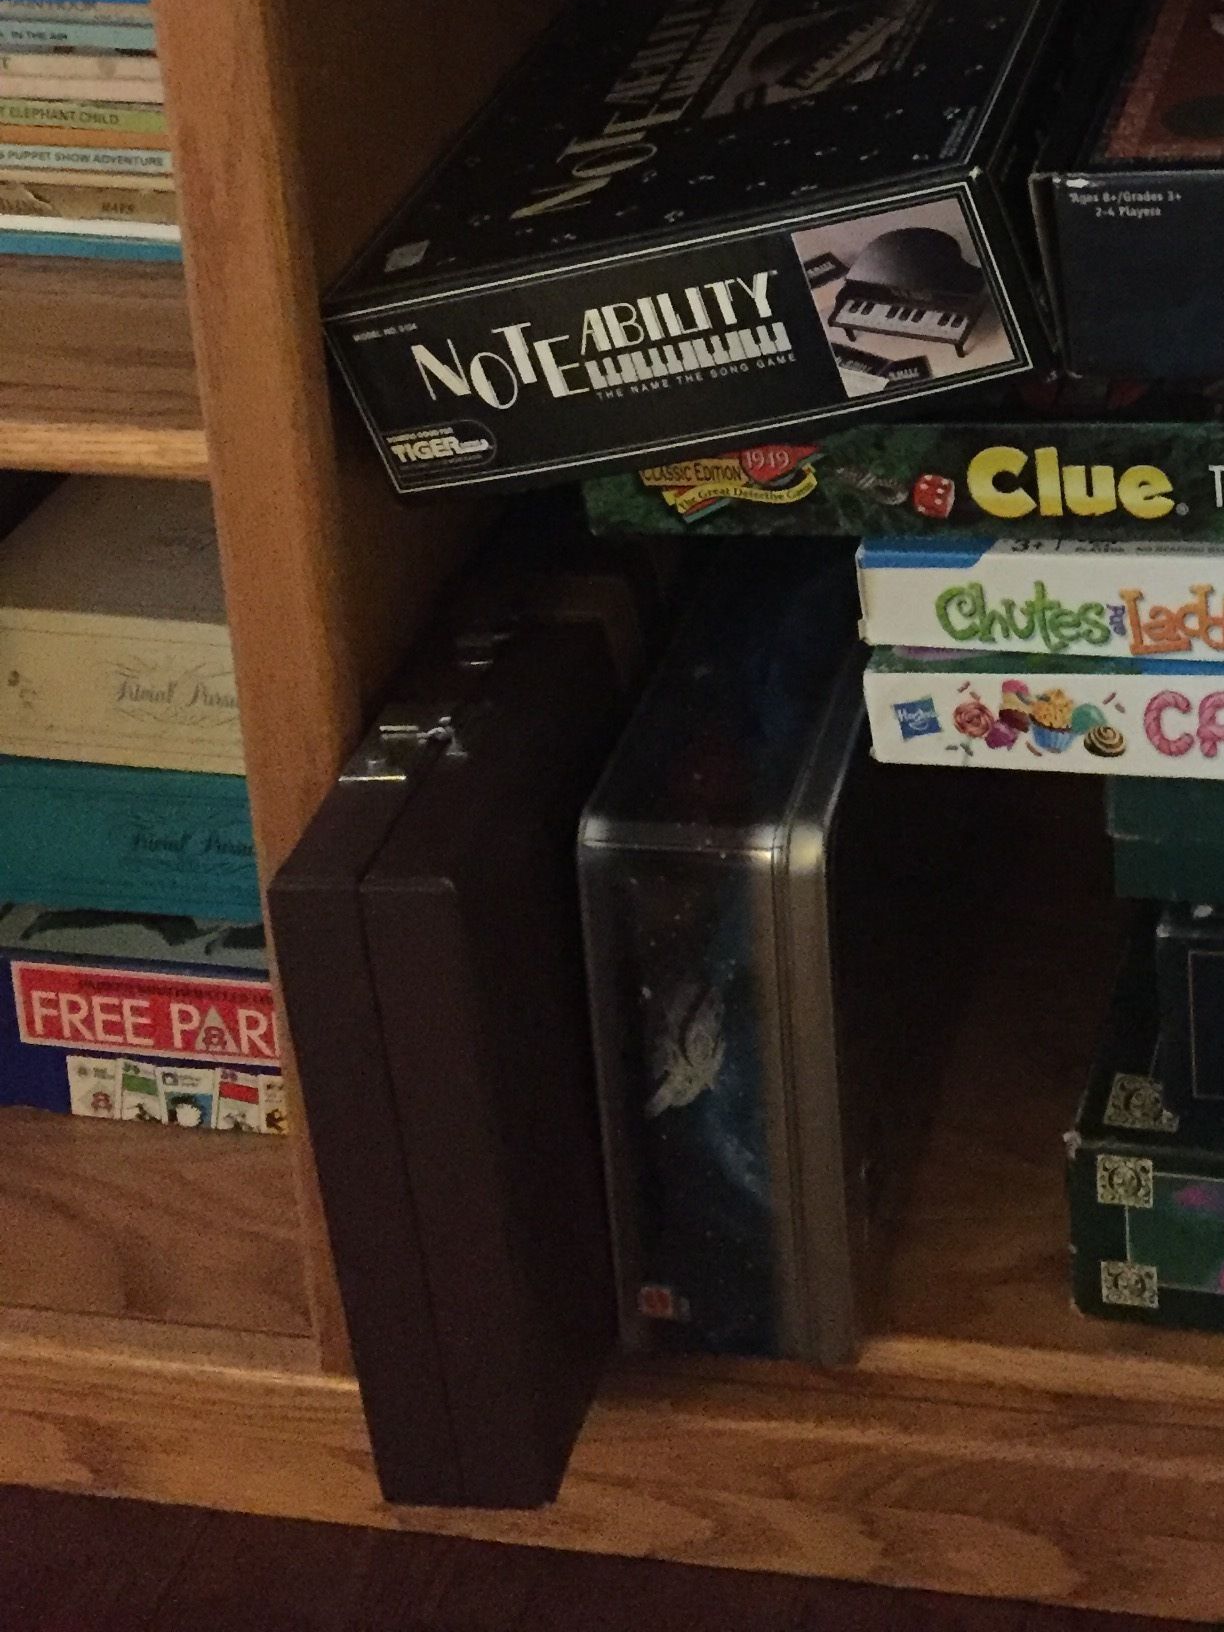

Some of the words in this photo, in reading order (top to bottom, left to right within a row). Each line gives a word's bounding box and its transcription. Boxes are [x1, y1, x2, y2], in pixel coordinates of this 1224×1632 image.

[25, 31, 46, 40] THE
[8, 104, 74, 124] ELEPHANT
[79, 111, 119, 126] CHILD
[7, 149, 52, 162] PUPPET
[54, 151, 92, 165] SHOW
[93, 152, 164, 168] ADVENTURE
[1118, 206, 1162, 219] Players
[595, 389, 625, 402] THE
[630, 378, 670, 394] NAME
[675, 371, 704, 384] THE
[708, 362, 750, 379] SONG
[756, 352, 798, 369] GAME
[390, 436, 462, 464] TIGER
[644, 464, 692, 482] CLASSIC
[693, 461, 741, 482] EDITION
[966, 446, 1177, 521] Clue
[679, 494, 696, 510] The
[697, 487, 730, 500] Great
[733, 486, 785, 501] Detective
[785, 481, 812, 499] Game
[935, 580, 1111, 654] Chutes
[30, 989, 155, 1047] FREE
